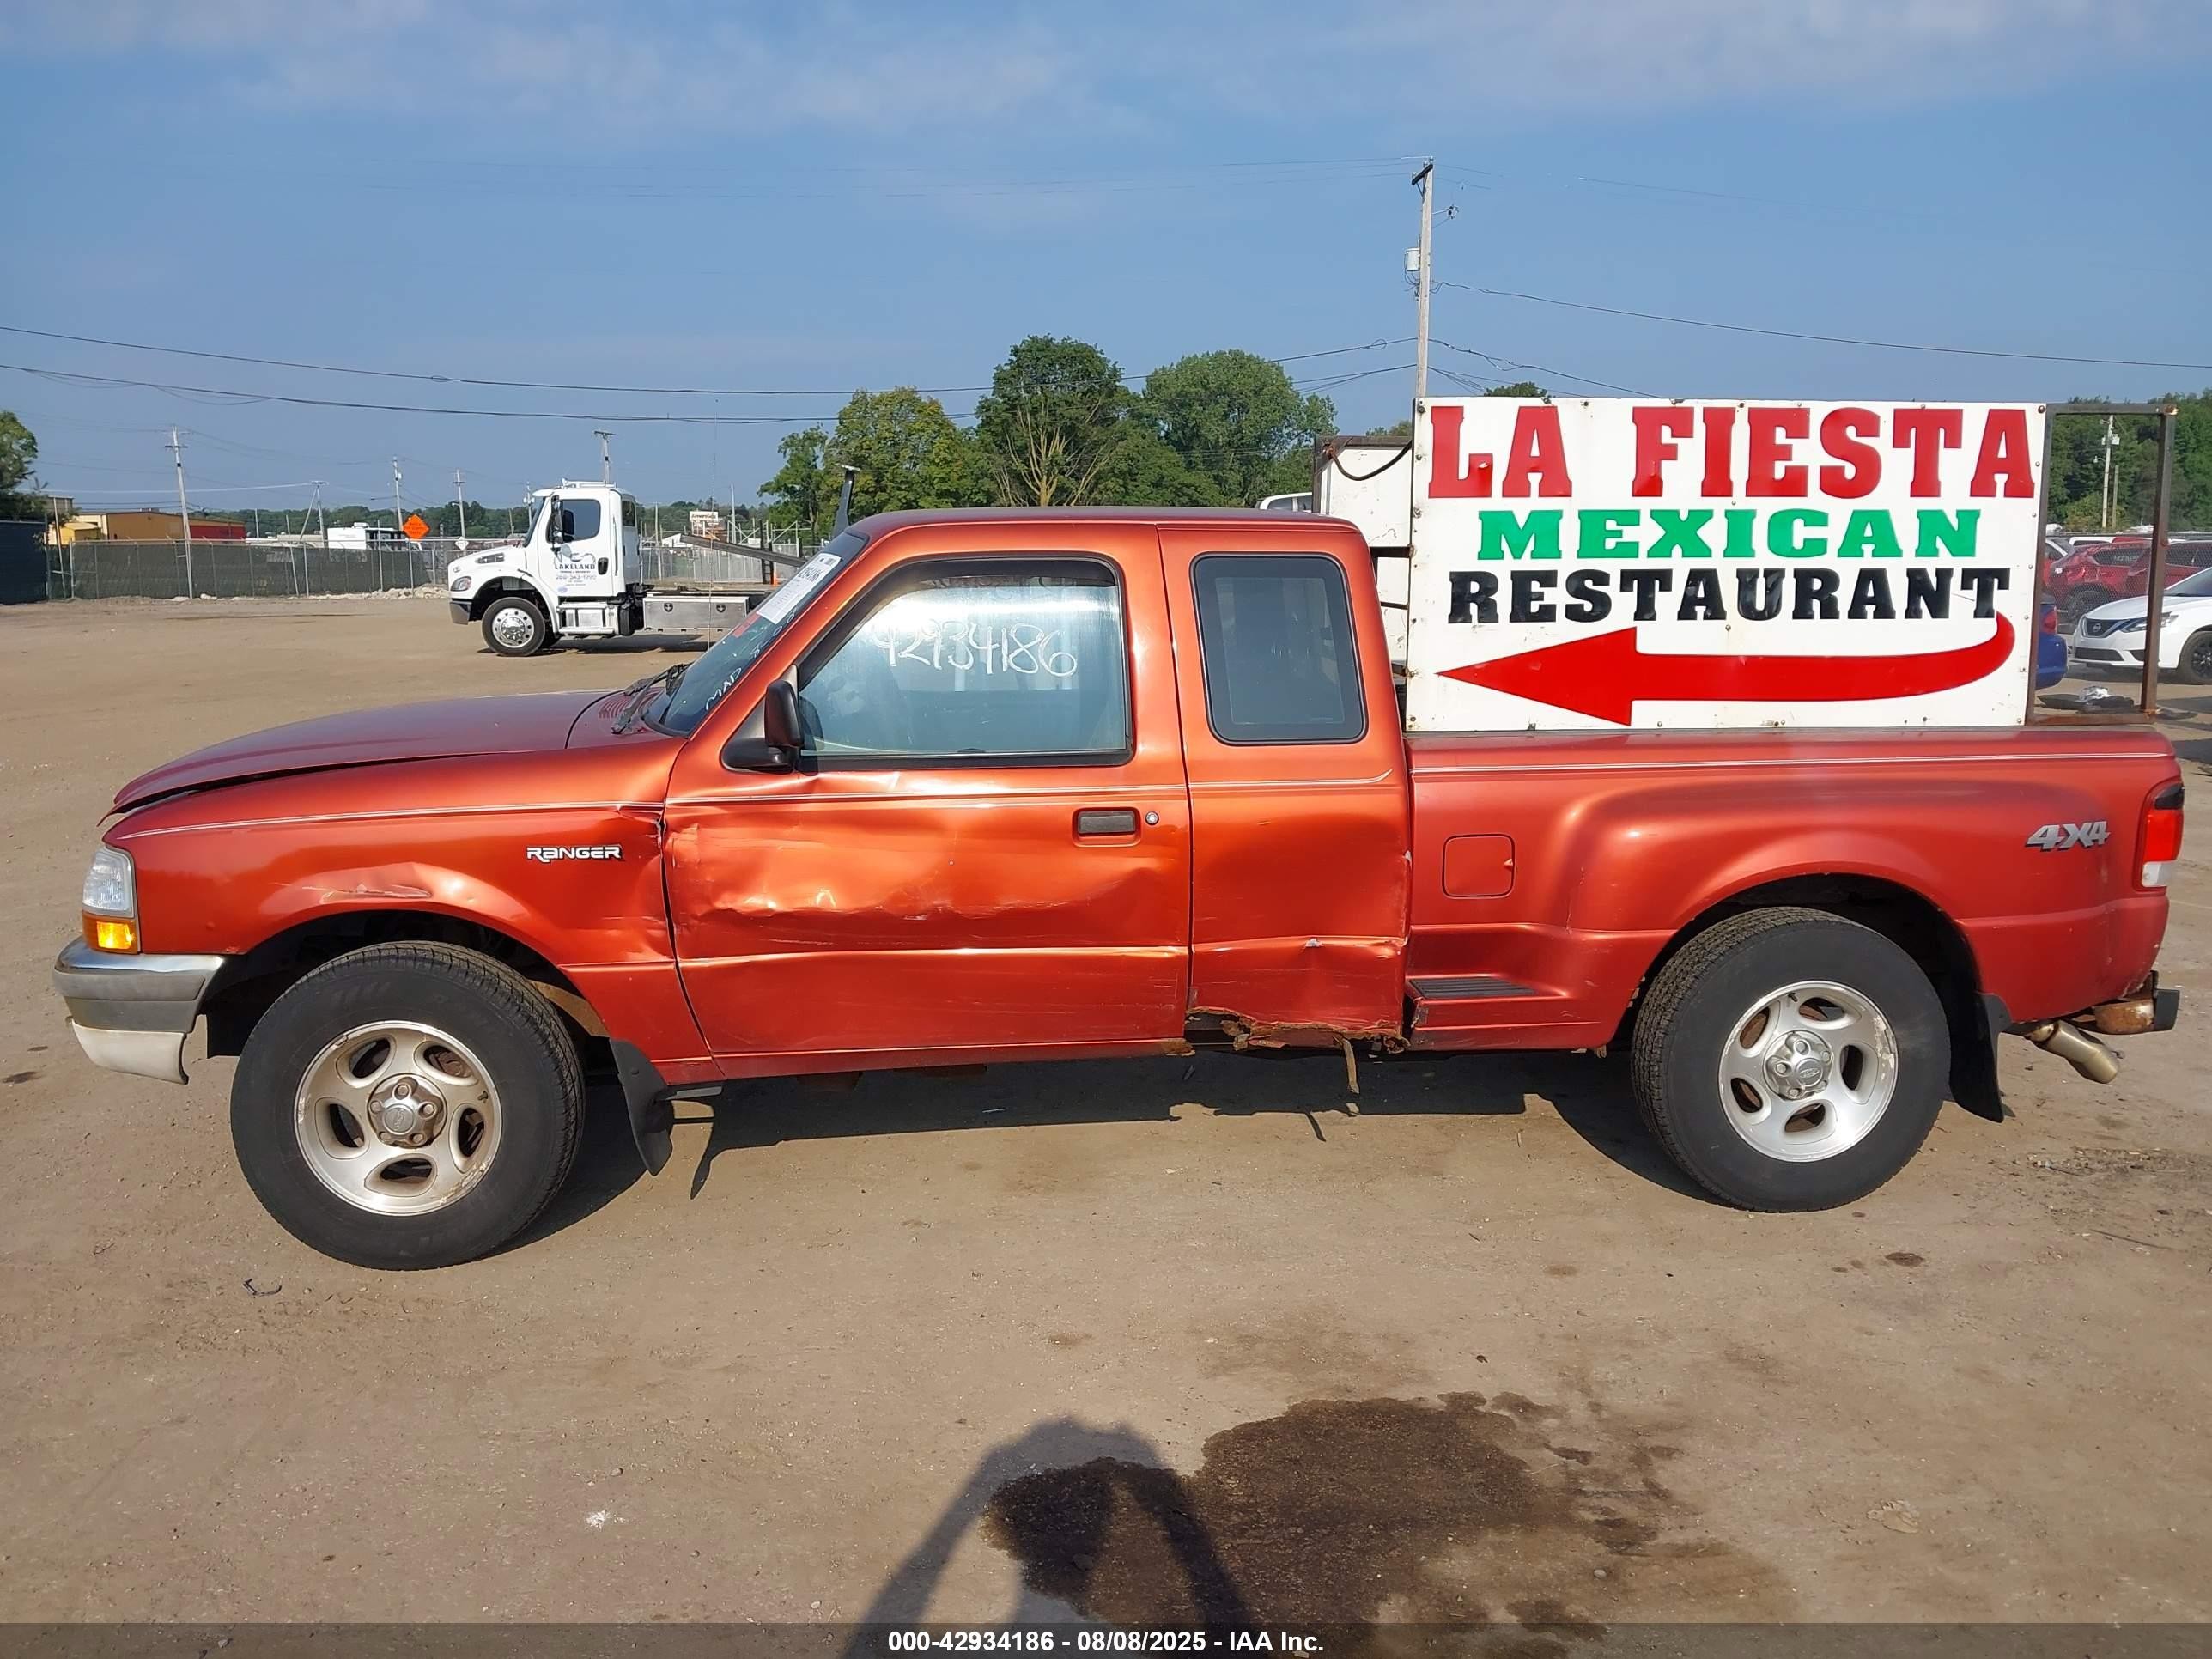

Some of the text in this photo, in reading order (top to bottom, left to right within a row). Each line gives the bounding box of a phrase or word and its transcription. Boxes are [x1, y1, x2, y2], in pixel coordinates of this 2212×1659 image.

[1428, 405, 2034, 499] LA FIESTA
[1478, 508, 1981, 559] MEXICAN
[1448, 567, 2011, 624] RESTAURANT
[872, 618, 1078, 677] 42934186
[526, 845, 622, 864] RANGER
